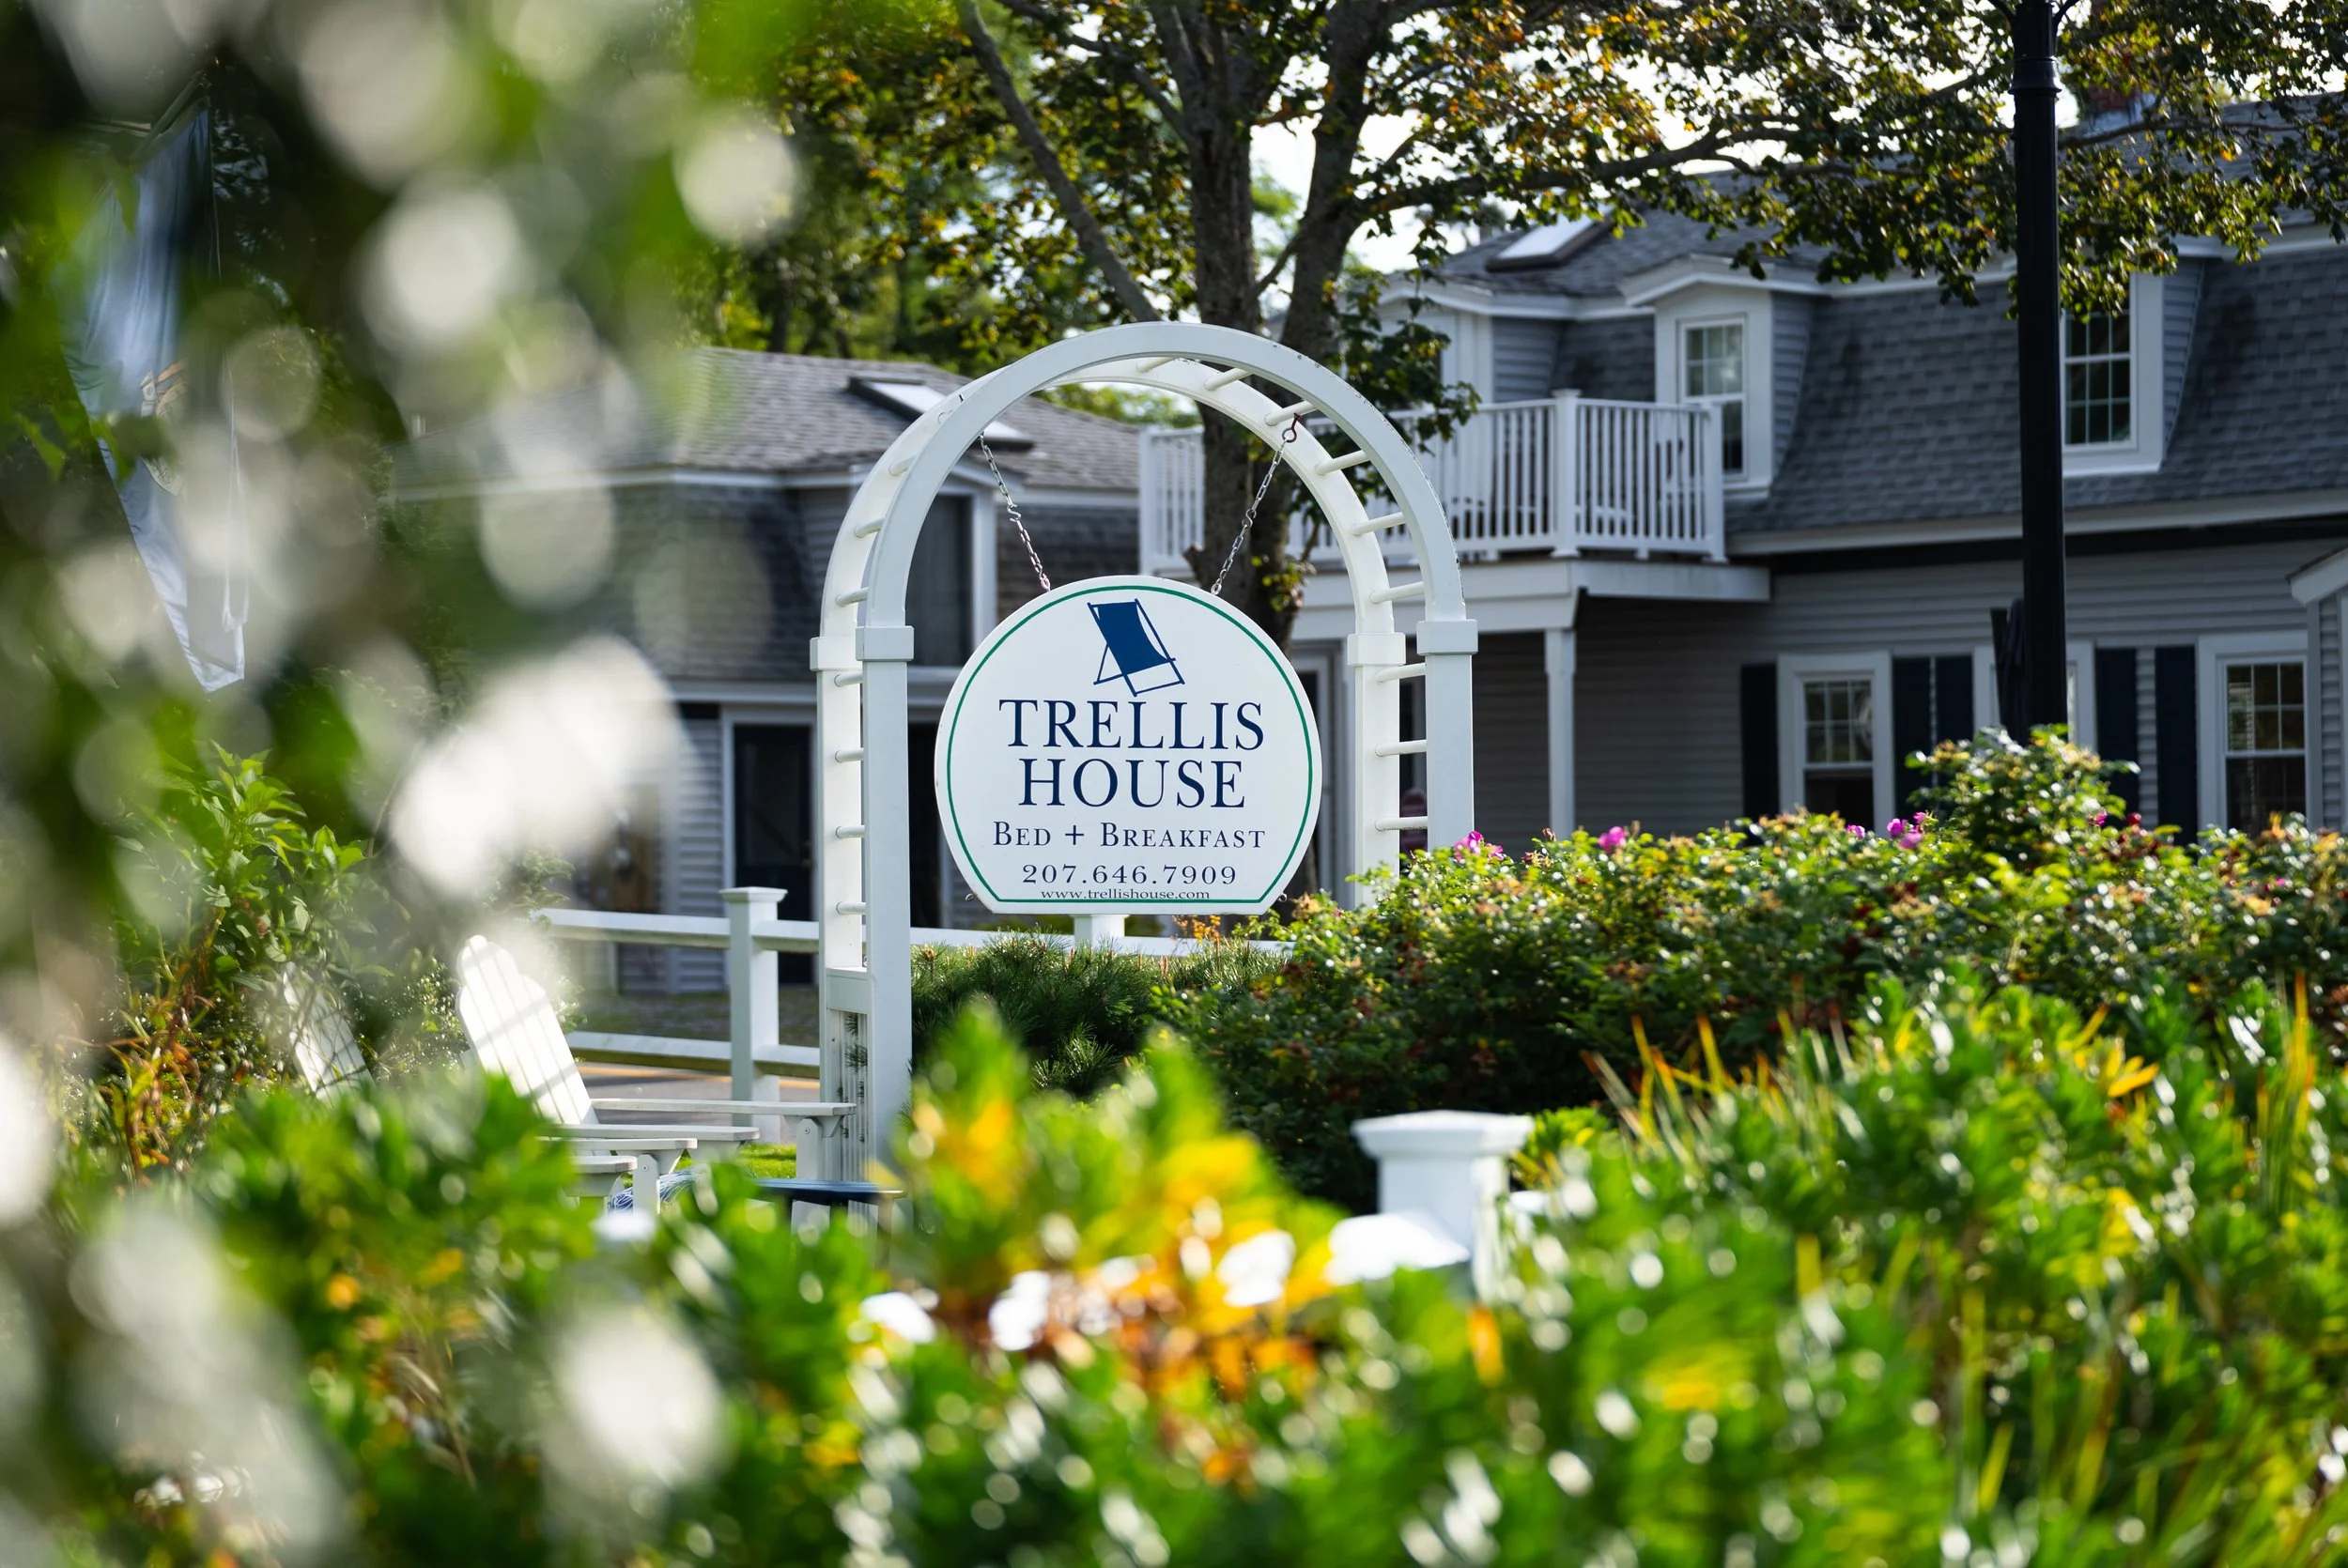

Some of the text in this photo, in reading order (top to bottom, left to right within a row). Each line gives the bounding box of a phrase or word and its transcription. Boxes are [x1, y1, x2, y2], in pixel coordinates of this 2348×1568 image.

[999, 699, 1264, 750] TRELLIS
[1018, 759, 1245, 808] HOUSE
[1064, 824, 1085, 845] +
[1023, 864, 1236, 884] 207.646.7909
[1042, 887, 1211, 899] www.trellishouse.com
